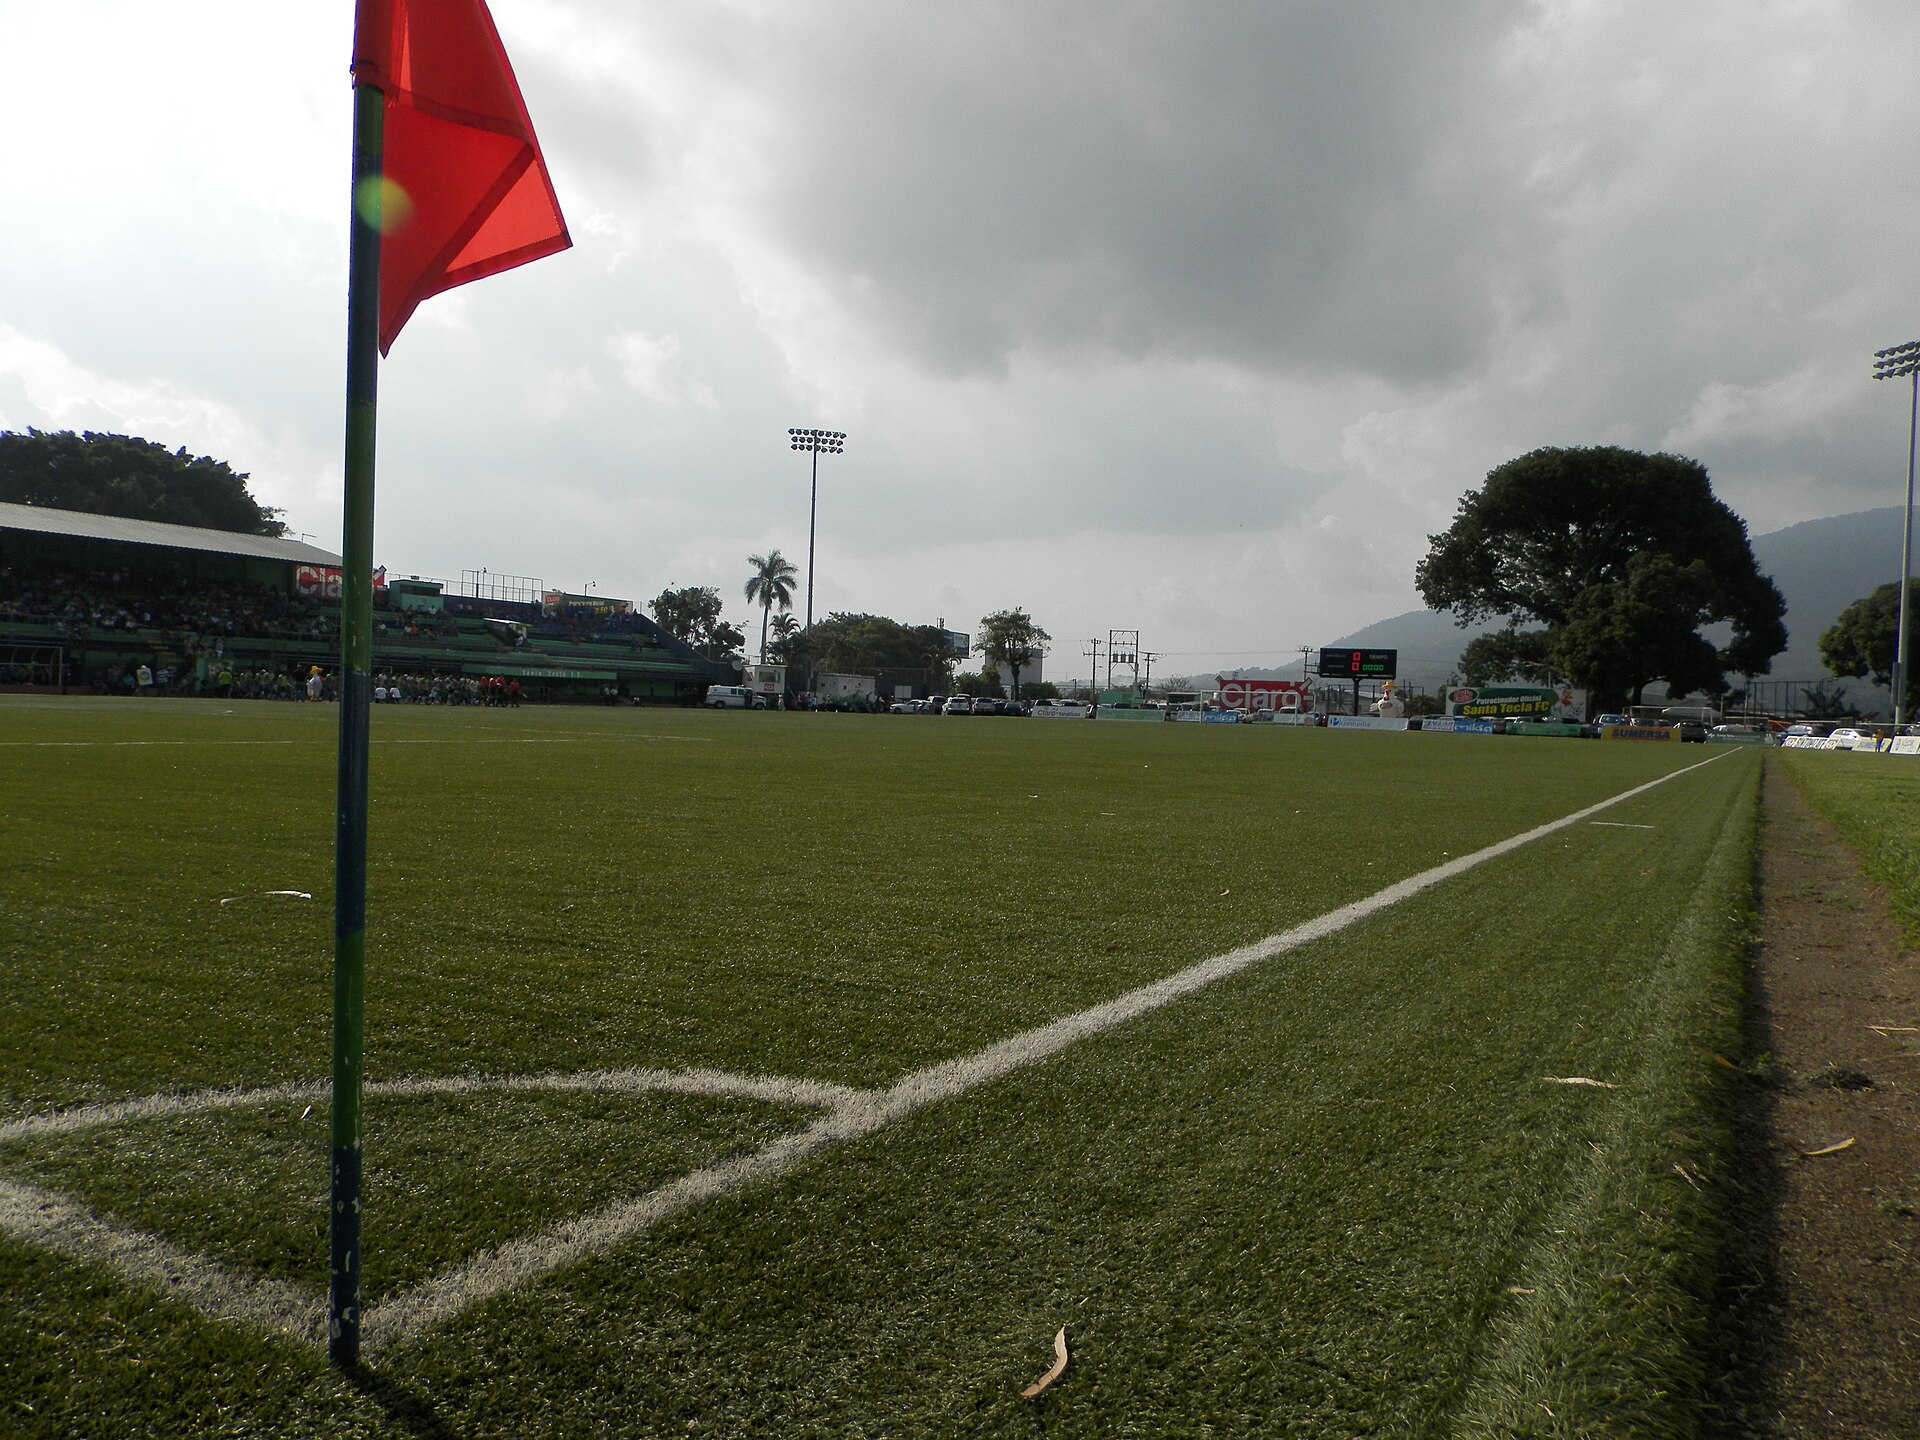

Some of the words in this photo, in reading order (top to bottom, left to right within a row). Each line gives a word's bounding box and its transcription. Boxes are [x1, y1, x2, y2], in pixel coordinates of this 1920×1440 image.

[296, 566, 374, 598] Cla
[1353, 652, 1361, 661] 0
[1352, 662, 1359, 671] 0
[1221, 683, 1302, 710] Claro
[1463, 704, 1498, 716] Santa
[1500, 702, 1532, 713] Tecla
[1534, 700, 1551, 711] FC
